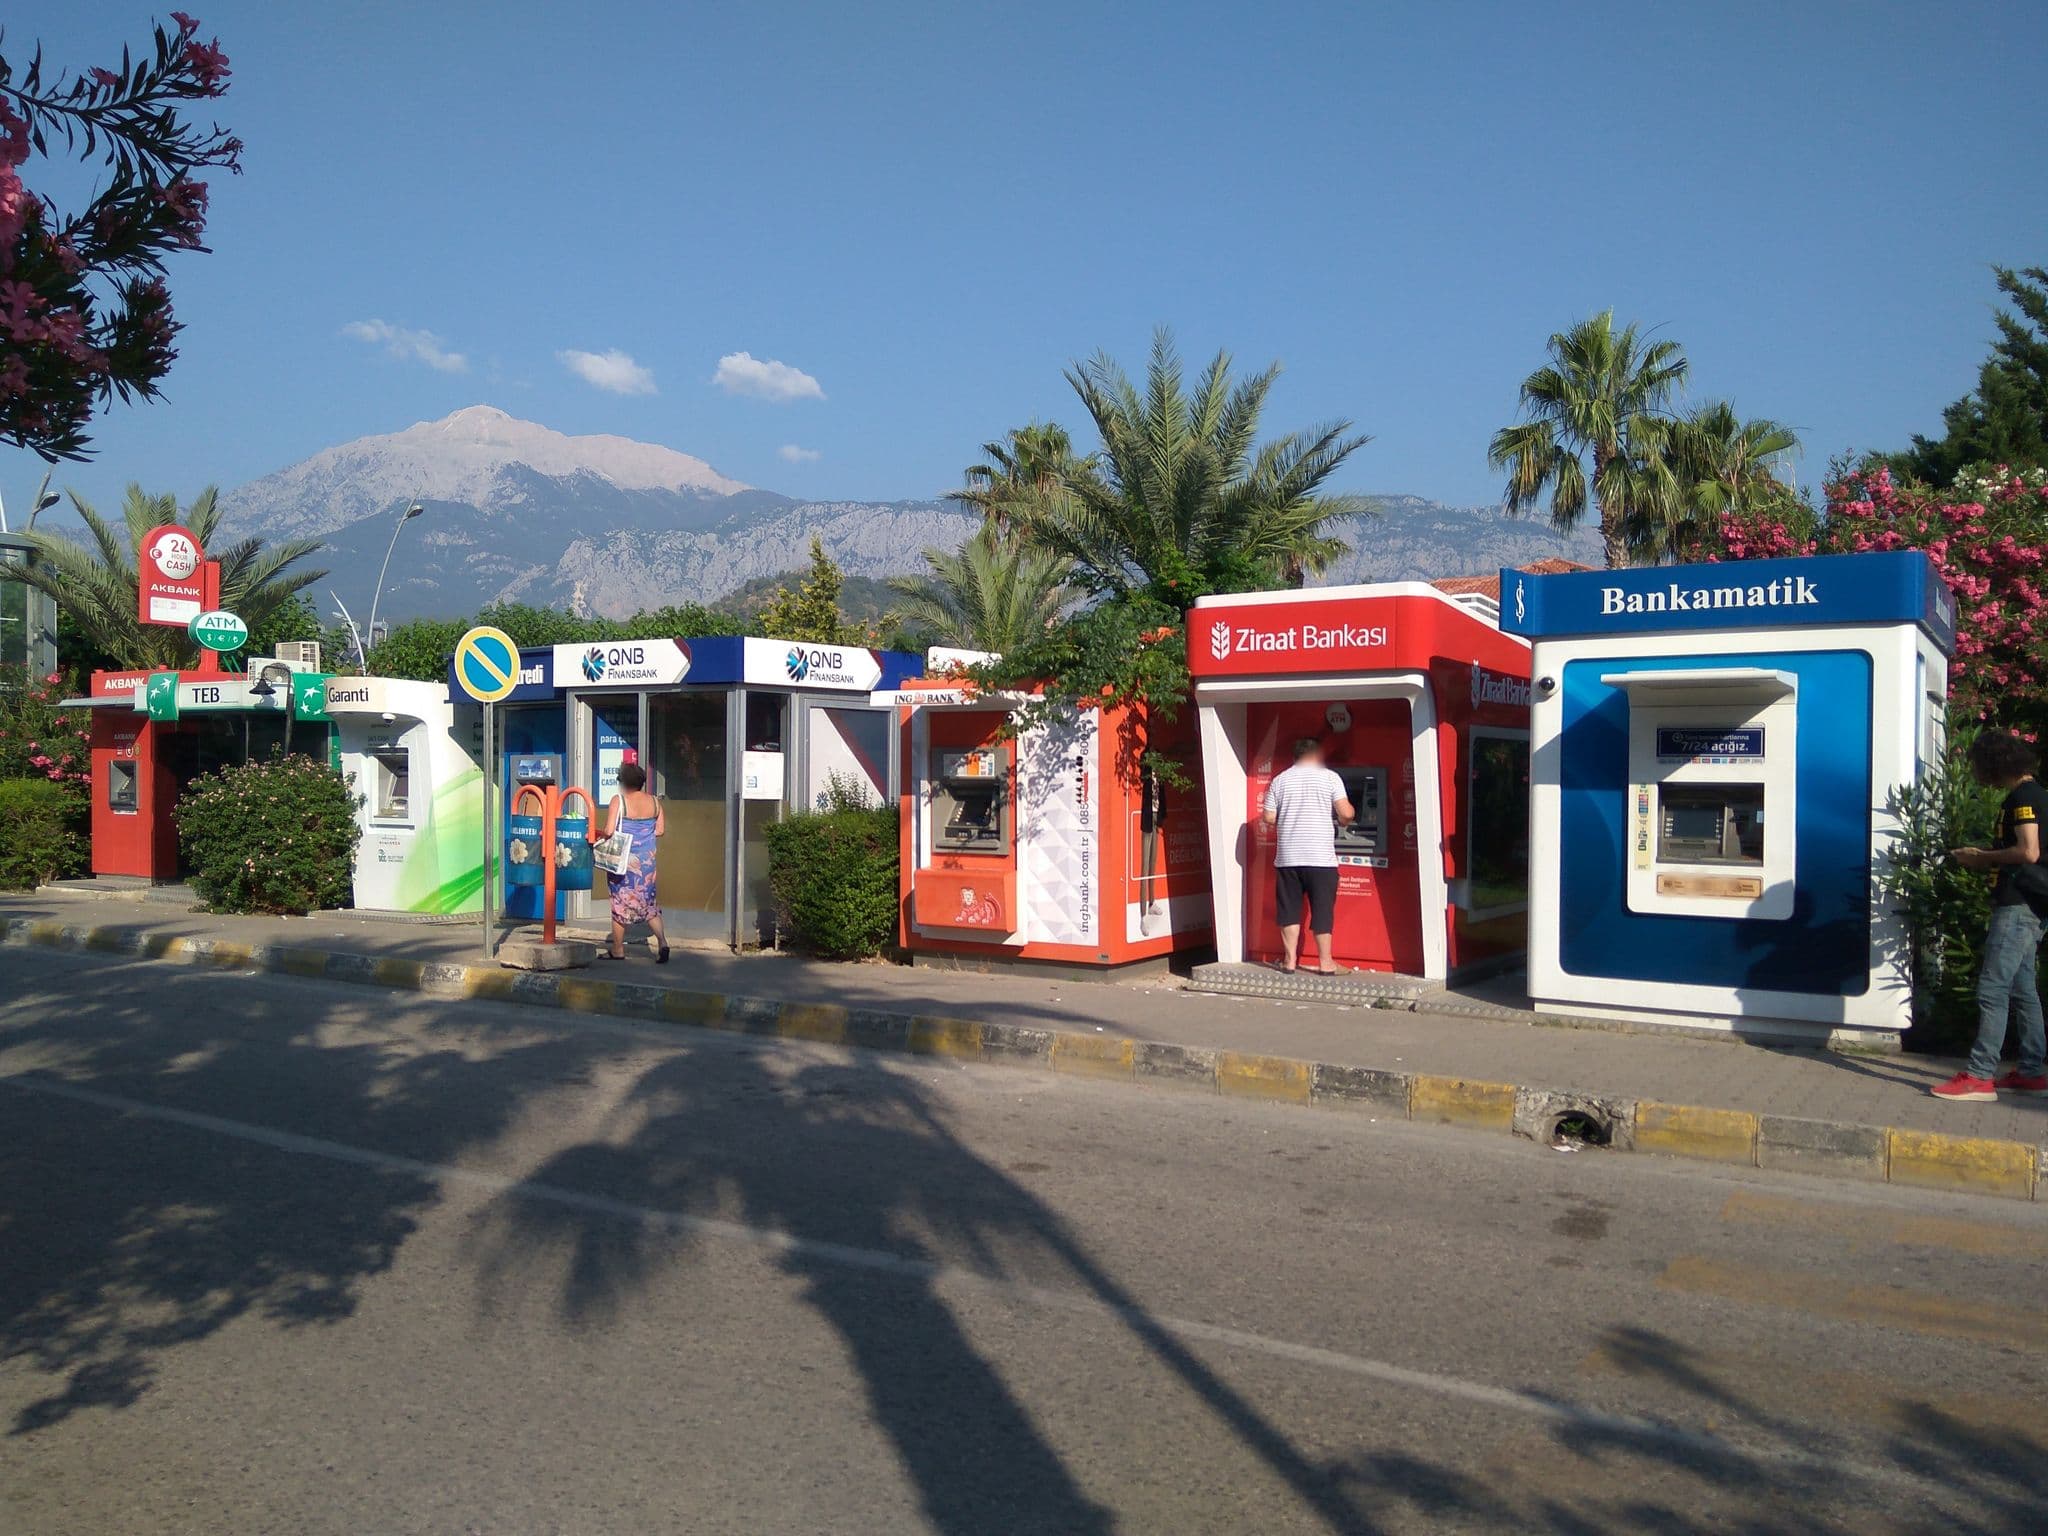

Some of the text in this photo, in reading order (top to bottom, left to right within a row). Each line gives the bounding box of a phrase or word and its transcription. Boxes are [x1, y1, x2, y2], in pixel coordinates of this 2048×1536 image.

[170, 540, 188, 554] 24
[166, 560, 191, 571] CASH
[150, 583, 200, 596] AKBANK
[1601, 577, 1818, 614] Bankamatik
[205, 617, 237, 629] ATM
[1236, 624, 1387, 652] Ziraat Bankası
[608, 647, 644, 666] QNB
[809, 650, 842, 669] QNB
[516, 664, 544, 685] redi
[104, 678, 145, 690] AKBANK
[192, 687, 220, 703] TEB
[328, 687, 368, 703] Garanti
[895, 694, 954, 704] ING BANK
[600, 735, 617, 745] para
[1711, 741, 1749, 754] açığız.
[1080, 836, 1091, 933] ingbank.com.tr
